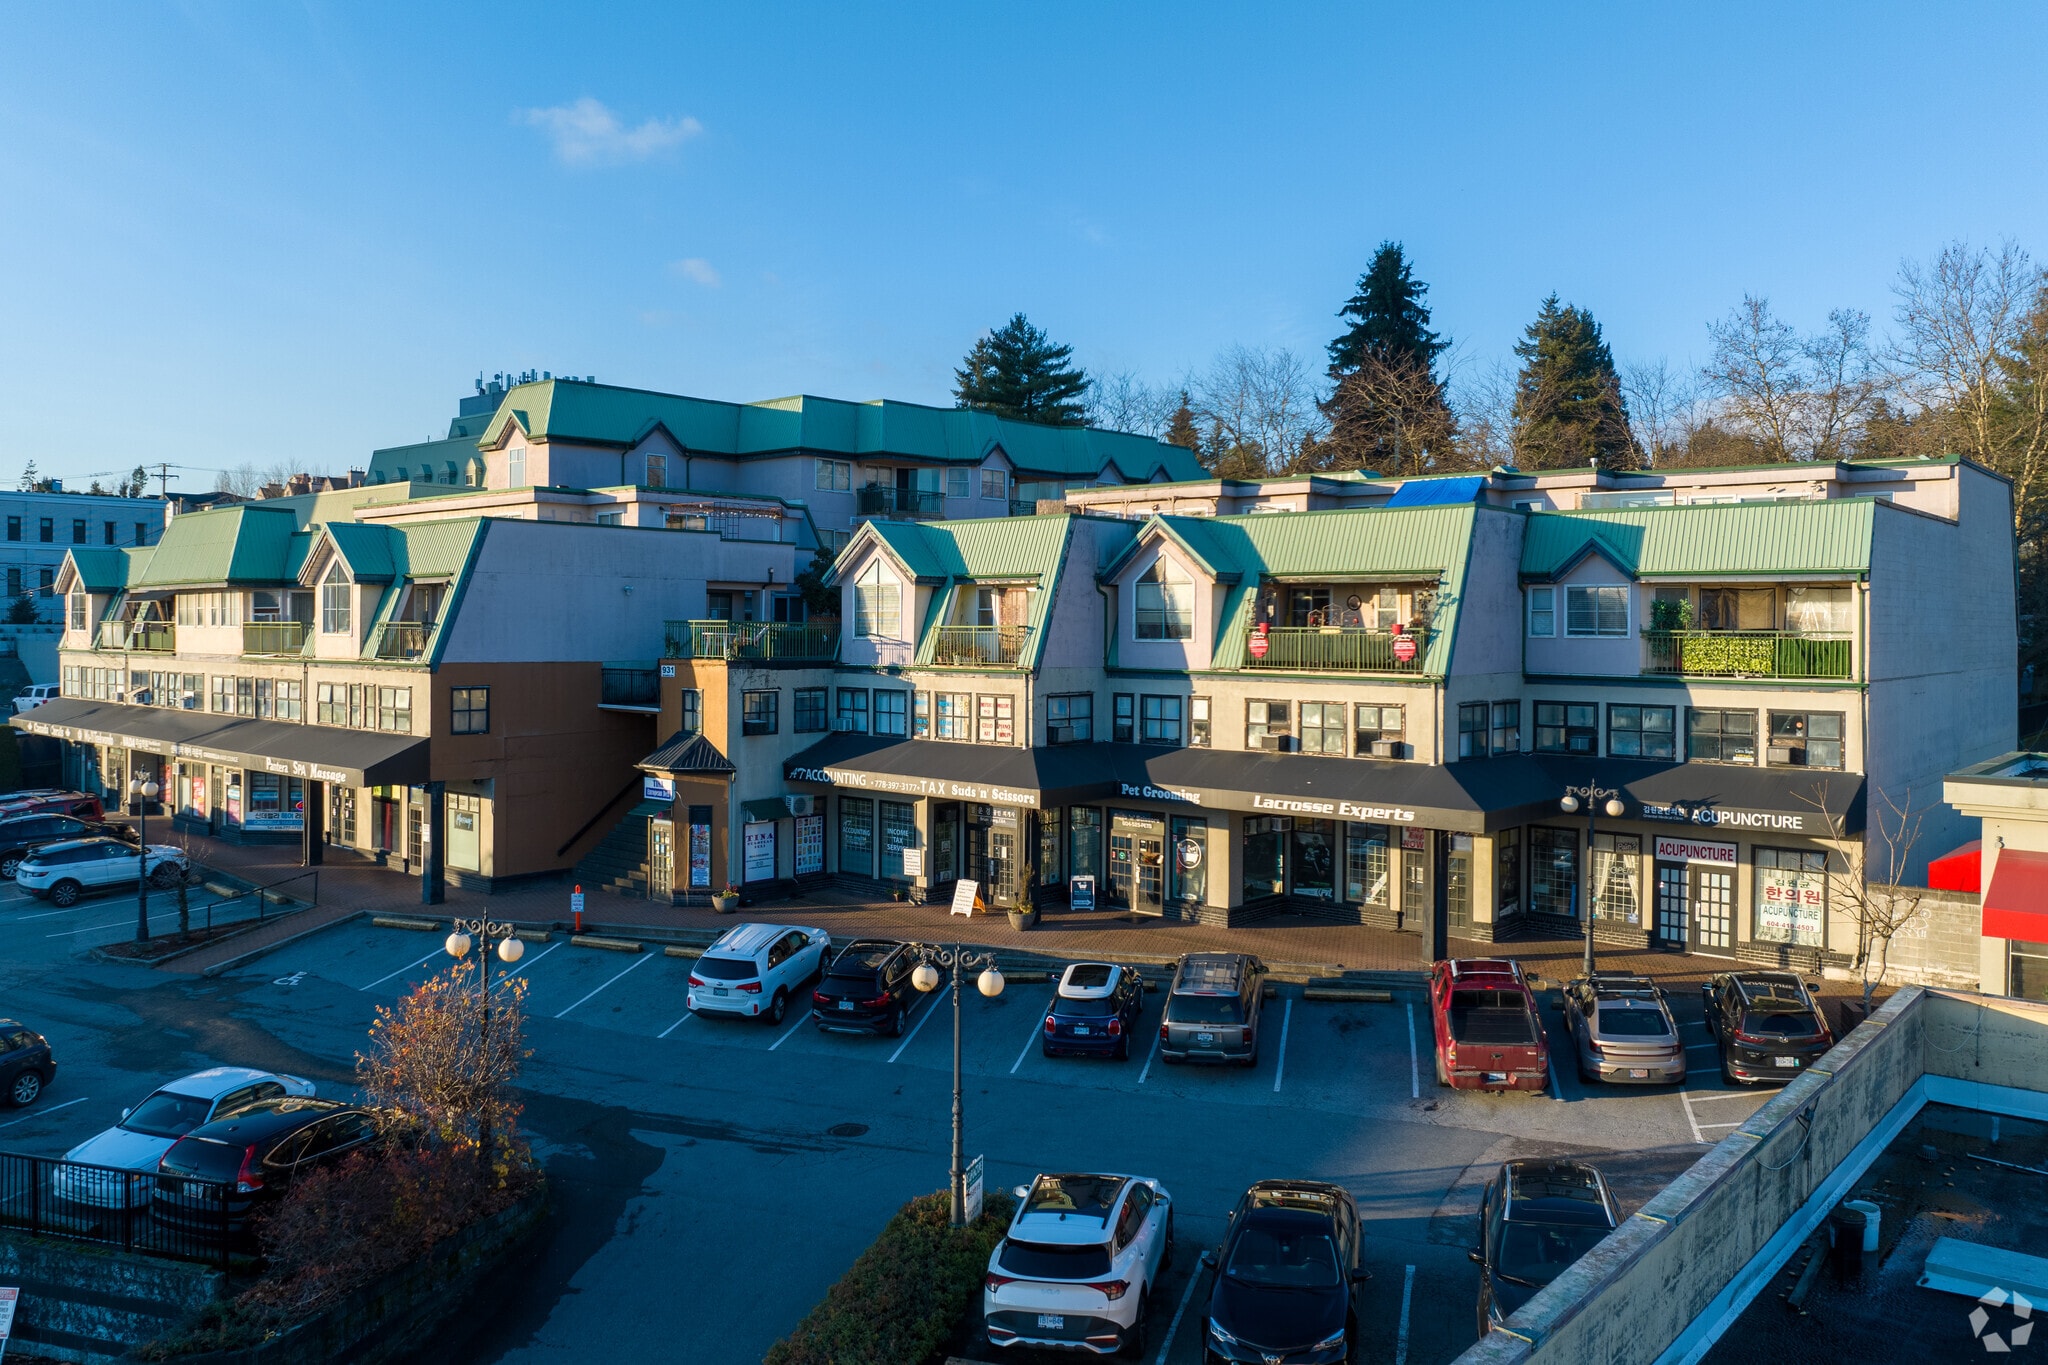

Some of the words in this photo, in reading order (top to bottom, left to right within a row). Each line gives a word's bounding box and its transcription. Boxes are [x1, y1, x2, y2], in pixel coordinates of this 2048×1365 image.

[662, 666, 674, 674] 931
[266, 756, 288, 773] Pantera
[292, 760, 306, 776] SPA
[310, 764, 346, 784] Massage
[806, 768, 866, 786] ACCOUNTING
[874, 780, 917, 792] 778-397-3177
[920, 780, 946, 795] TAX
[952, 784, 976, 798] Suds
[992, 788, 1034, 804] Scissors
[1121, 783, 1140, 796] Pet
[1142, 786, 1200, 805] Grooming
[1253, 795, 1334, 814] Lacrosse
[1338, 802, 1415, 822] Experts
[1691, 809, 1803, 830] ACUPUNCTURE
[746, 832, 774, 842] TINA
[842, 826, 871, 836] ACCOUNTING
[887, 828, 909, 836] INCOME
[892, 836, 904, 844] TAX
[1403, 840, 1424, 848] NOW
[1658, 842, 1734, 862] ACUPUNCTURE
[1766, 886, 1820, 905] 한의원
[1763, 905, 1818, 920] ACUPUNCTURE
